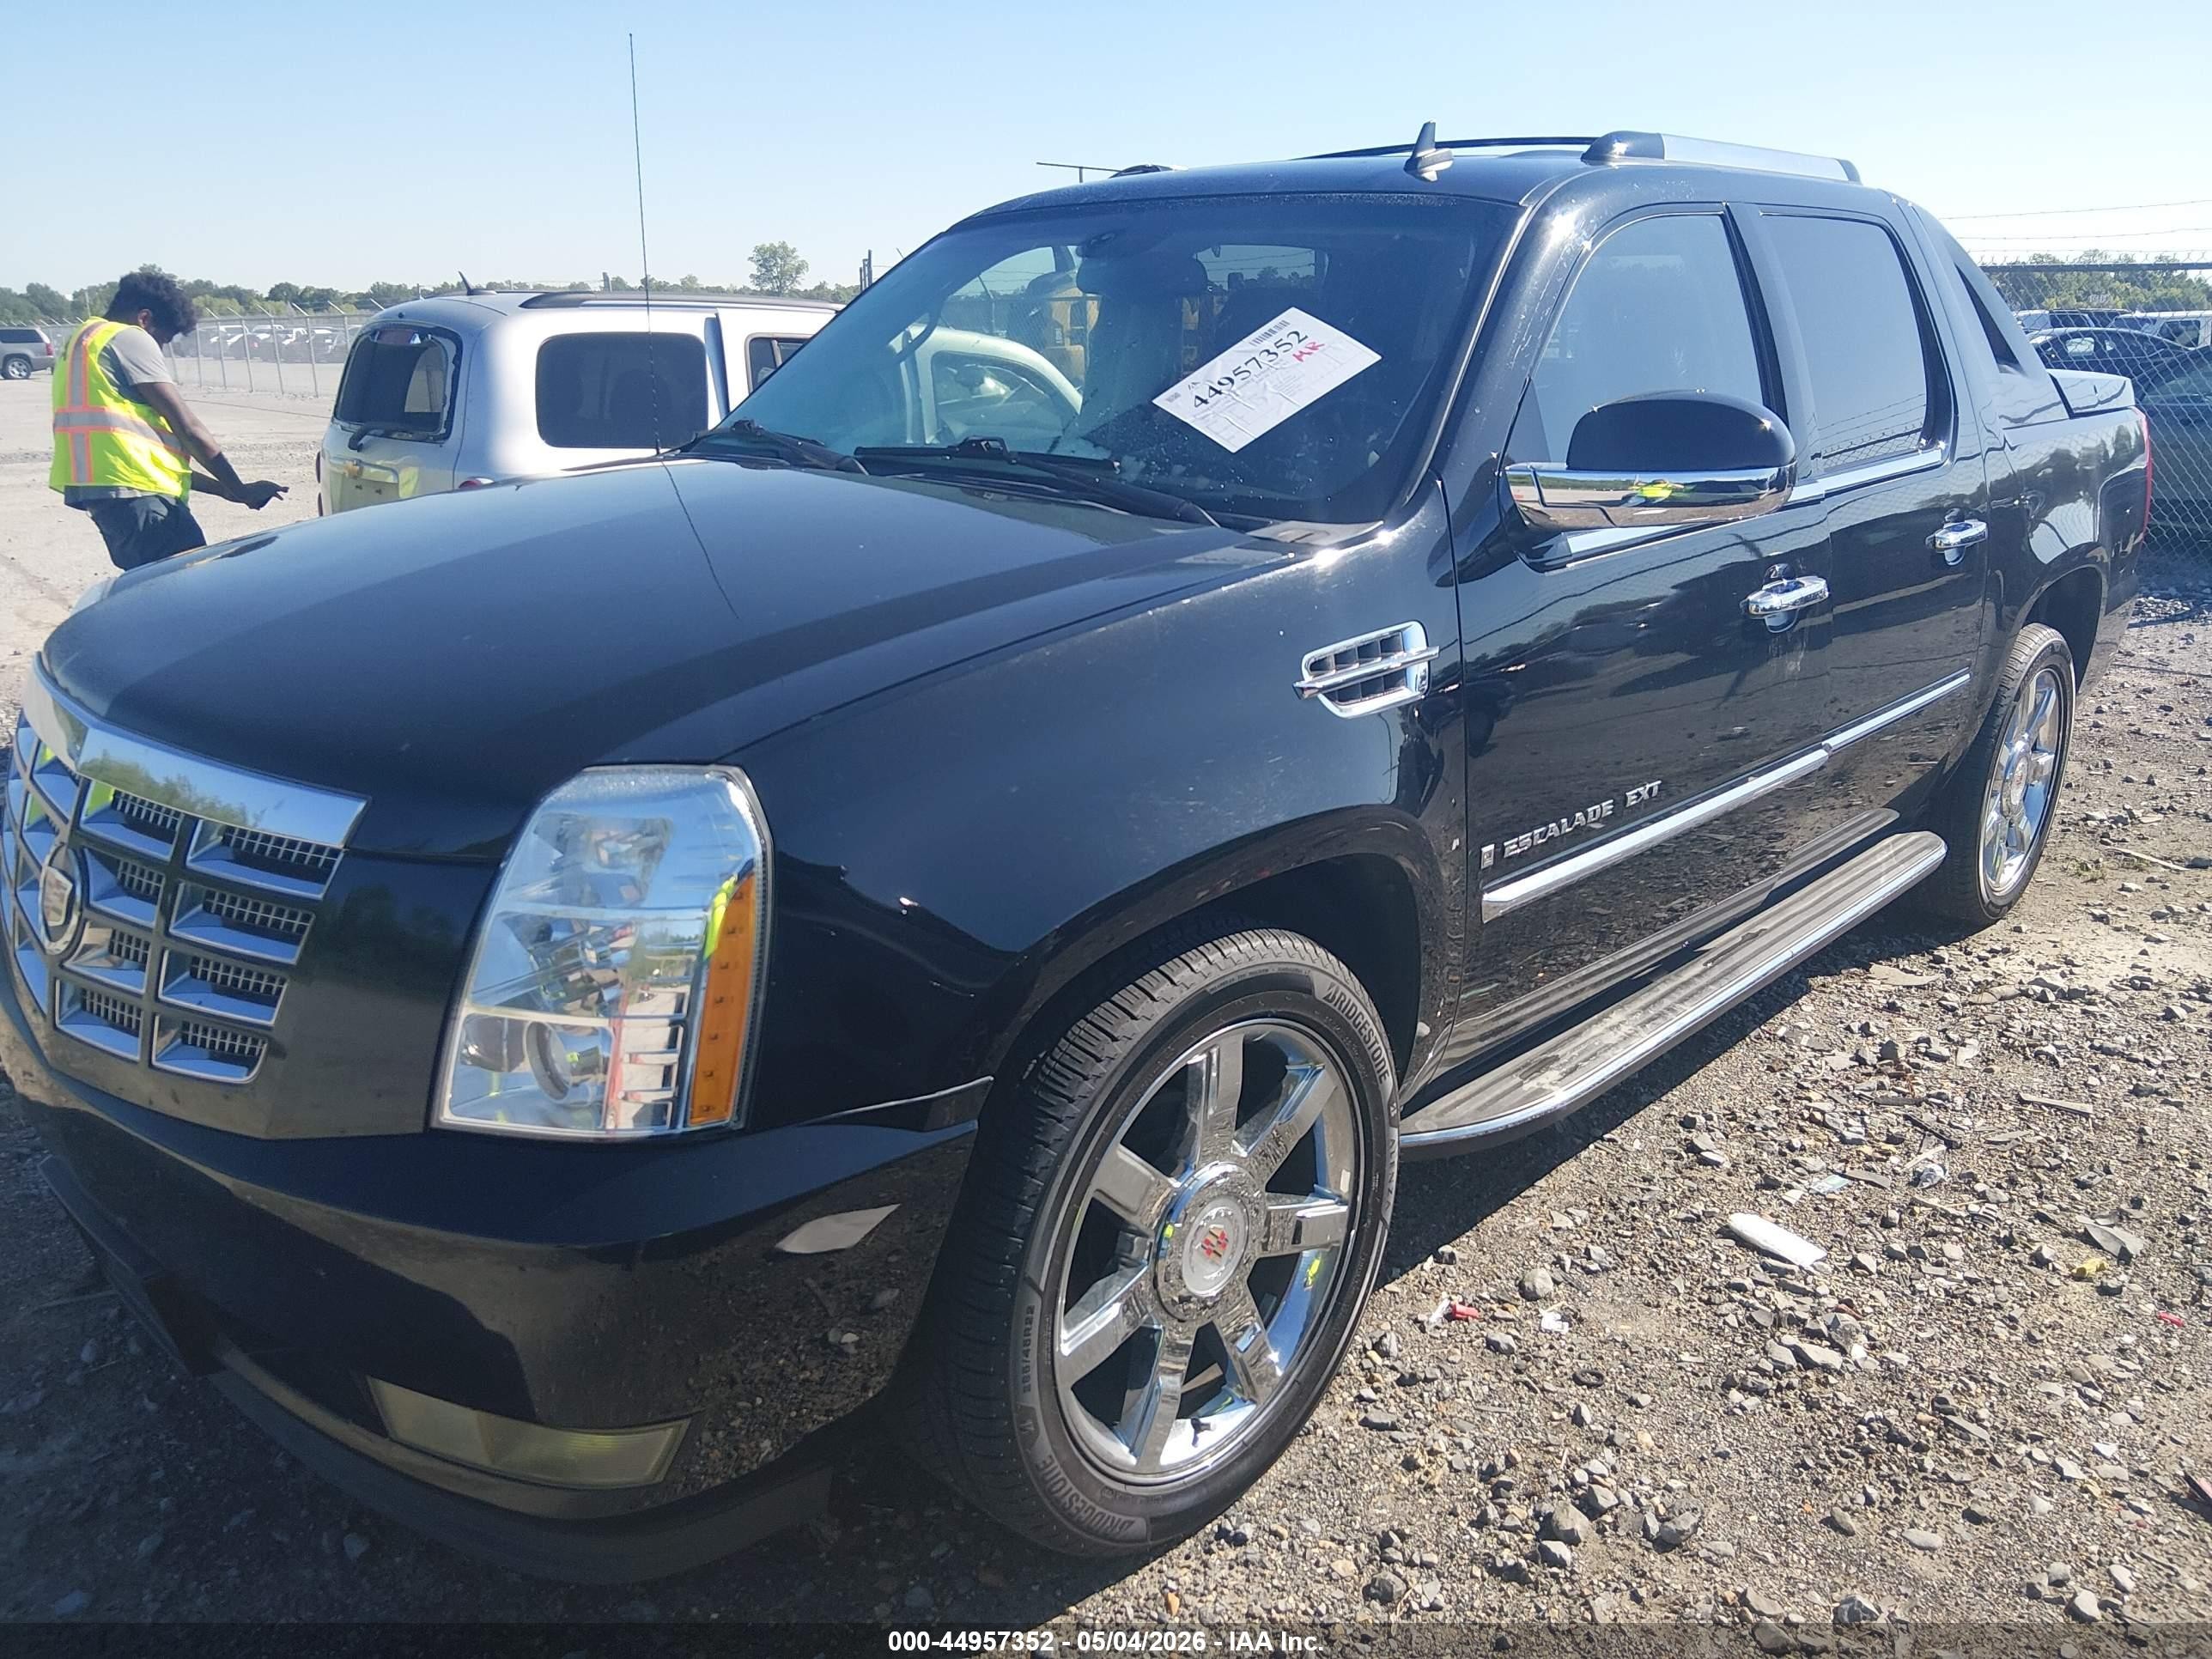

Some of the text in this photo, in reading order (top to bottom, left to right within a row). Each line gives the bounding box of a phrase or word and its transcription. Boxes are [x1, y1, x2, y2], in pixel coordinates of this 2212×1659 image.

[1194, 331, 1309, 408] 44957352
[1503, 780, 1662, 859] ESCALADE EXT
[1322, 981, 1389, 1085] BRIDGESTONE
[1036, 1454, 1136, 1539] BRIDGESTONE
